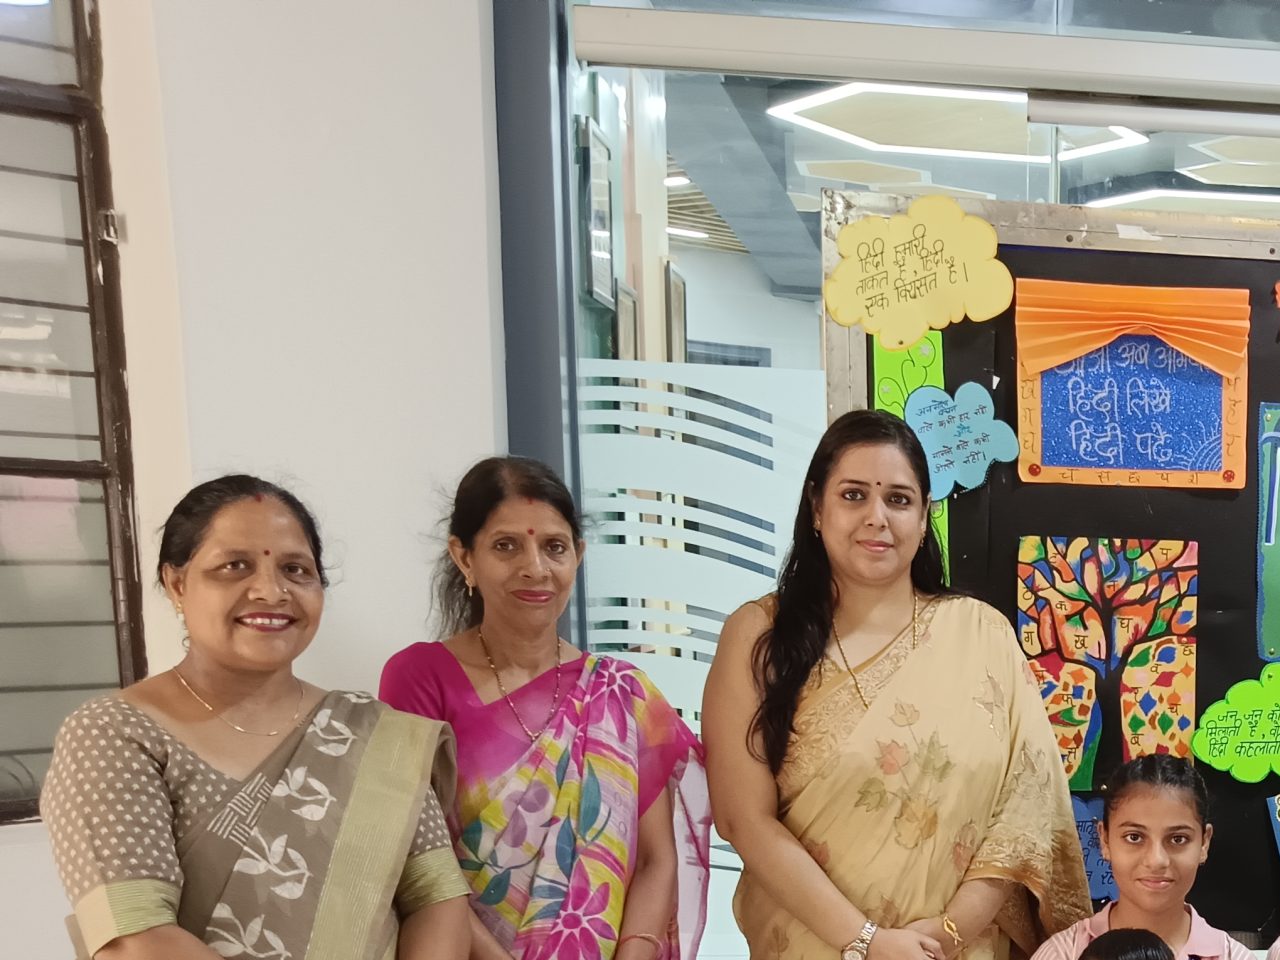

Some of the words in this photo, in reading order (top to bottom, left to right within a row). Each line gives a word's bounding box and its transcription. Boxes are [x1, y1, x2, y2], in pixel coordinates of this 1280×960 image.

[857, 237, 885, 273] हिंदी
[893, 223, 926, 261] हमारी
[855, 270, 888, 296] ताकत
[920, 239, 944, 272] हिंदी
[864, 292, 889, 318] एक
[1206, 719, 1242, 738] मिलाती
[1218, 710, 1238, 723] जन
[1244, 710, 1263, 723] जन
